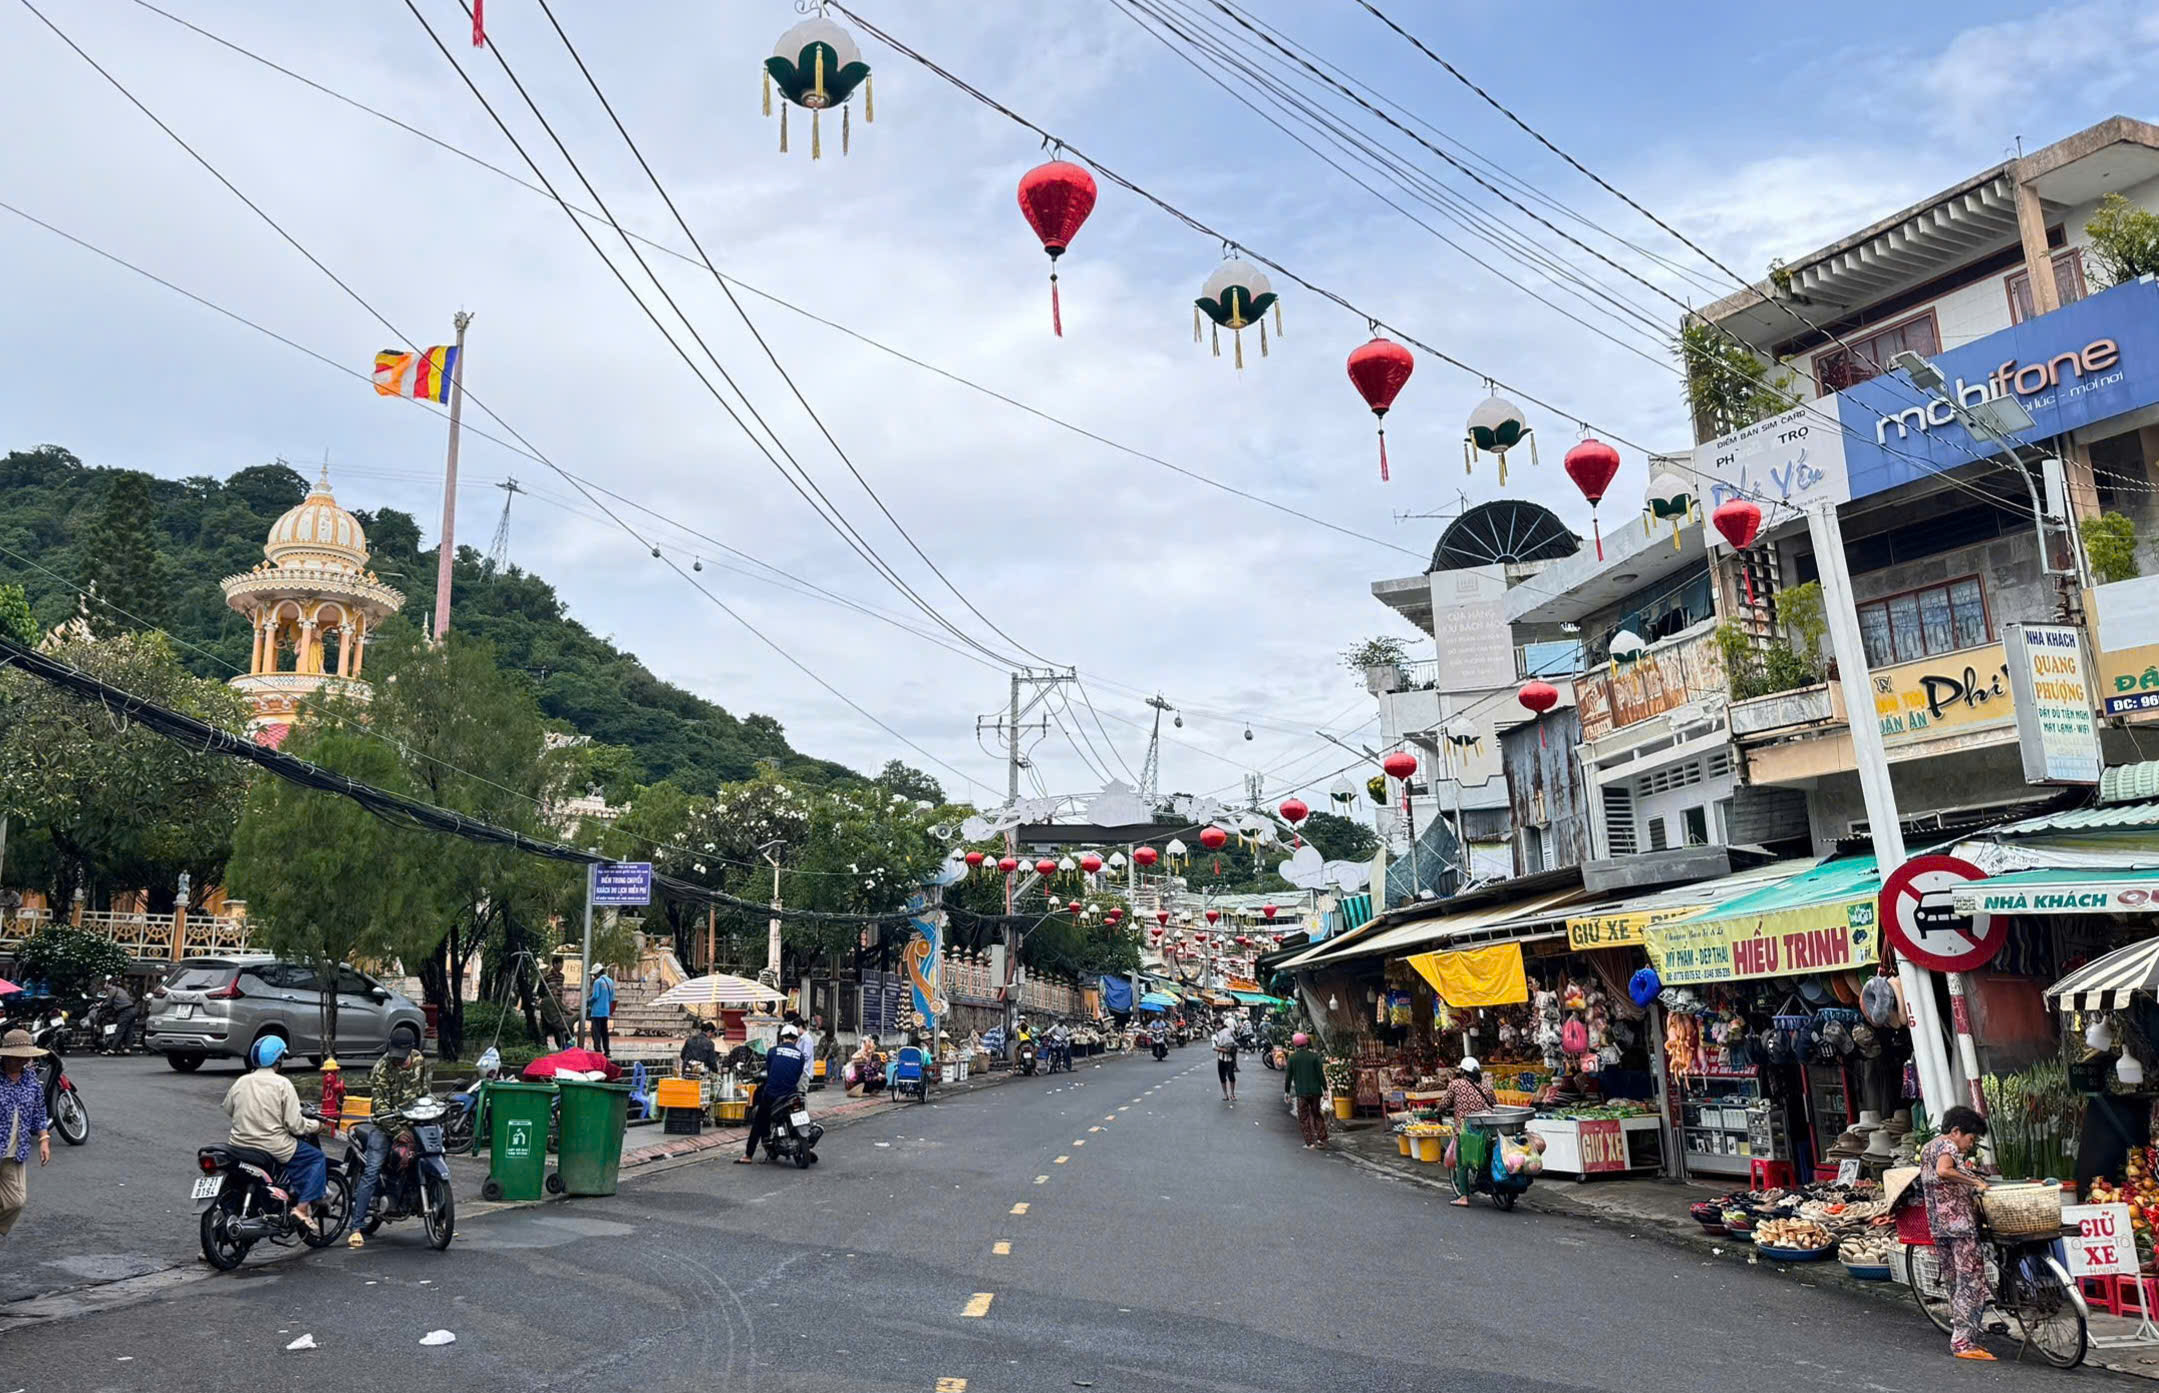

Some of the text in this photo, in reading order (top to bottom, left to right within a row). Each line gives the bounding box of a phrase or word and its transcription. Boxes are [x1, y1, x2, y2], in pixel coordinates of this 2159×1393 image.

[1875, 338, 2120, 444] mobifone
[1761, 420, 1778, 432] SIM
[1780, 410, 1806, 425] CARD
[1778, 426, 1809, 444] TRỌ
[2025, 628, 2077, 648] NHÀ KHÁCH
[2034, 654, 2077, 676] QUANG
[1919, 666, 2005, 718] Phi
[2034, 679, 2085, 705] PHƯỢNG
[2113, 695, 2159, 711] ĐC: 96
[1984, 892, 2029, 910] NHÀ
[2033, 890, 2108, 909] KHÁCH
[1572, 916, 1601, 945] GIỮ
[1608, 918, 1631, 941] XE
[1732, 920, 1850, 975] HIẾU TRINH
[1582, 1127, 1624, 1163] GIỮ XE
[2078, 1211, 2116, 1238] GIỮ
[2083, 1245, 2119, 1266] XE
